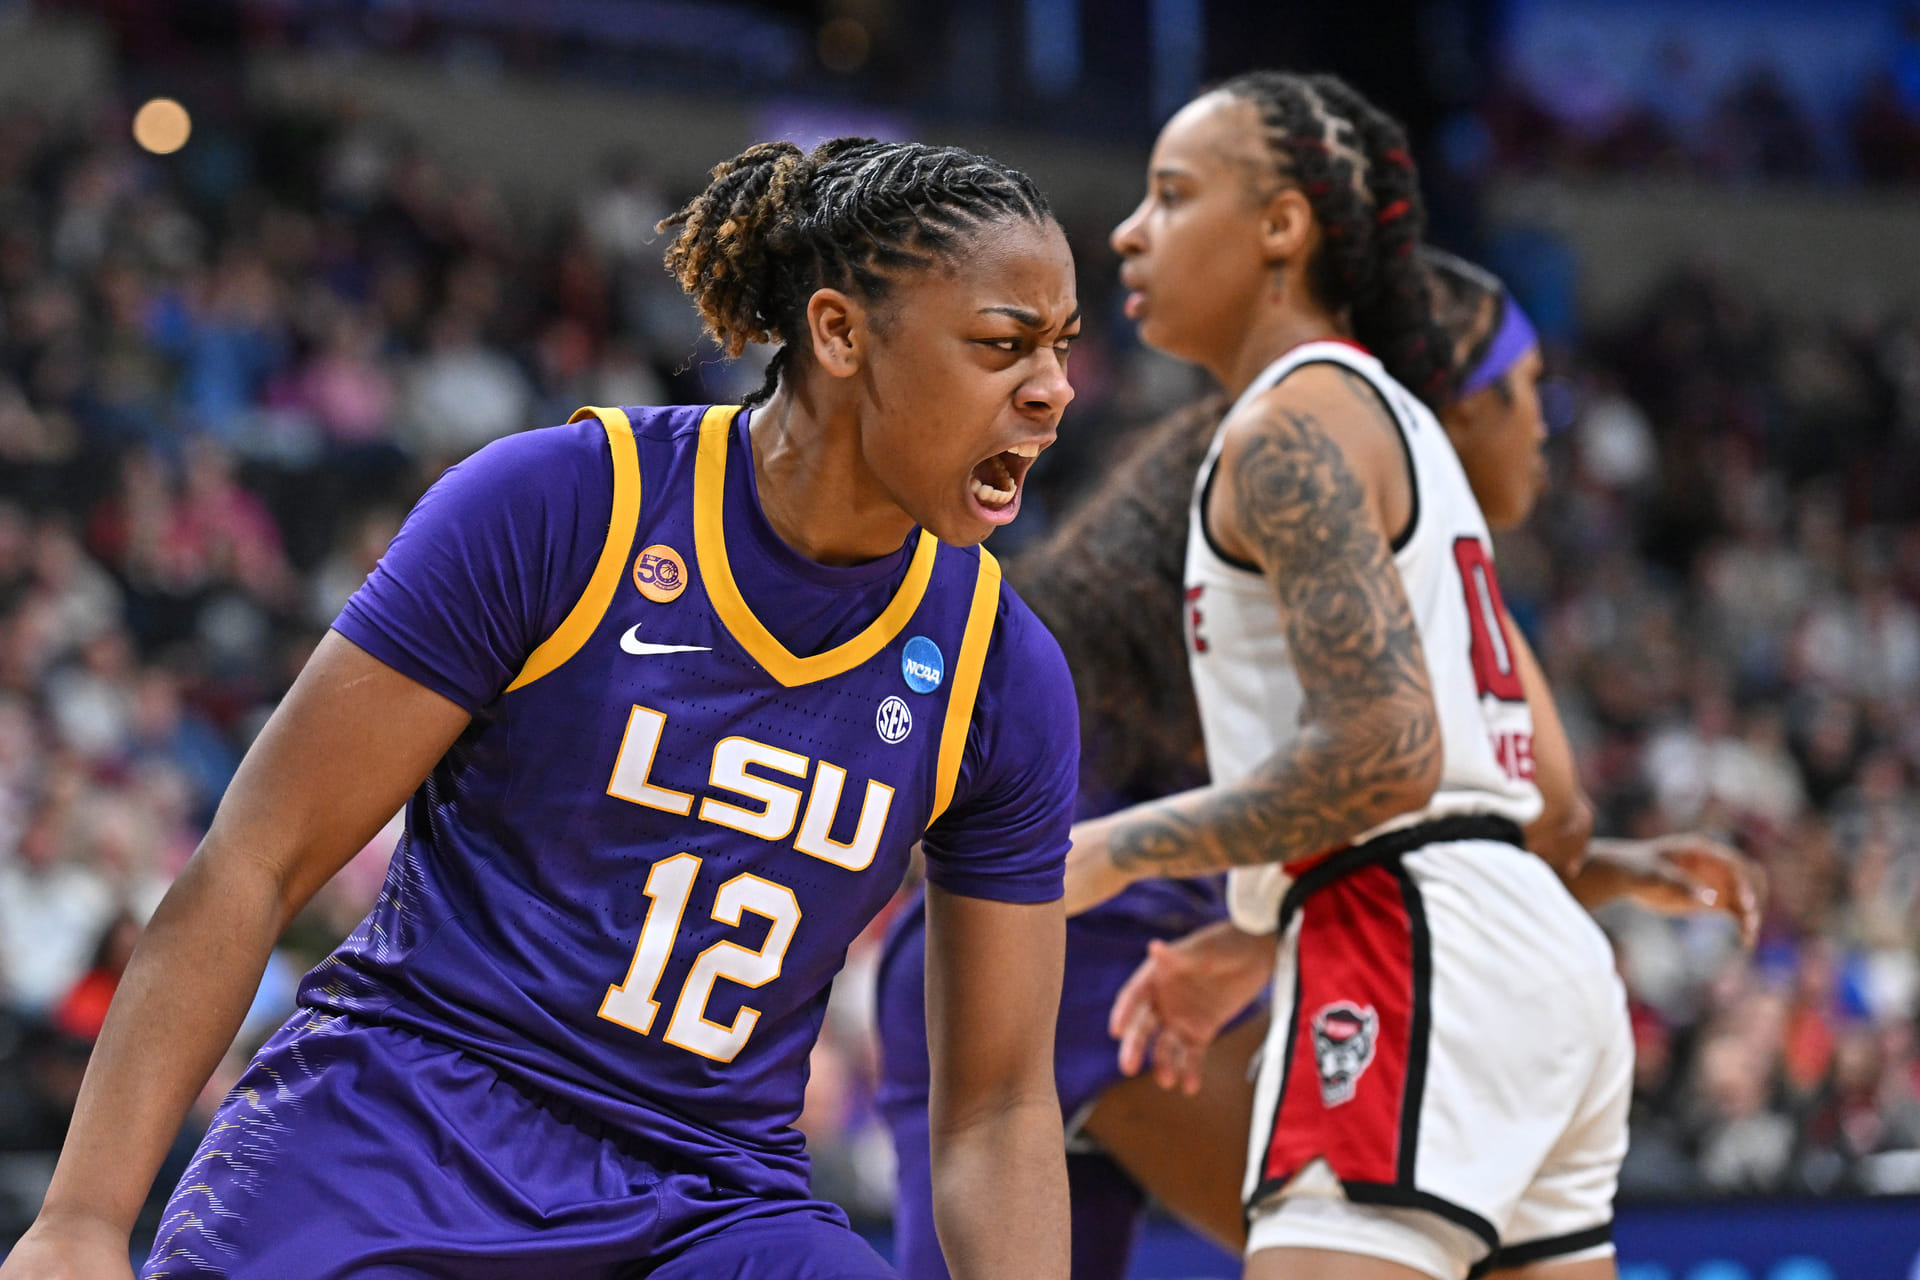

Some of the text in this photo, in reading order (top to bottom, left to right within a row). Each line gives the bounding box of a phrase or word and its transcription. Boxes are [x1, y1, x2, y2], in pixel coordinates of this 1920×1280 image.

[879, 699, 909, 740] SEC
[905, 658, 940, 685] NCAA
[606, 703, 896, 872] LSU
[597, 852, 802, 1063] 12
